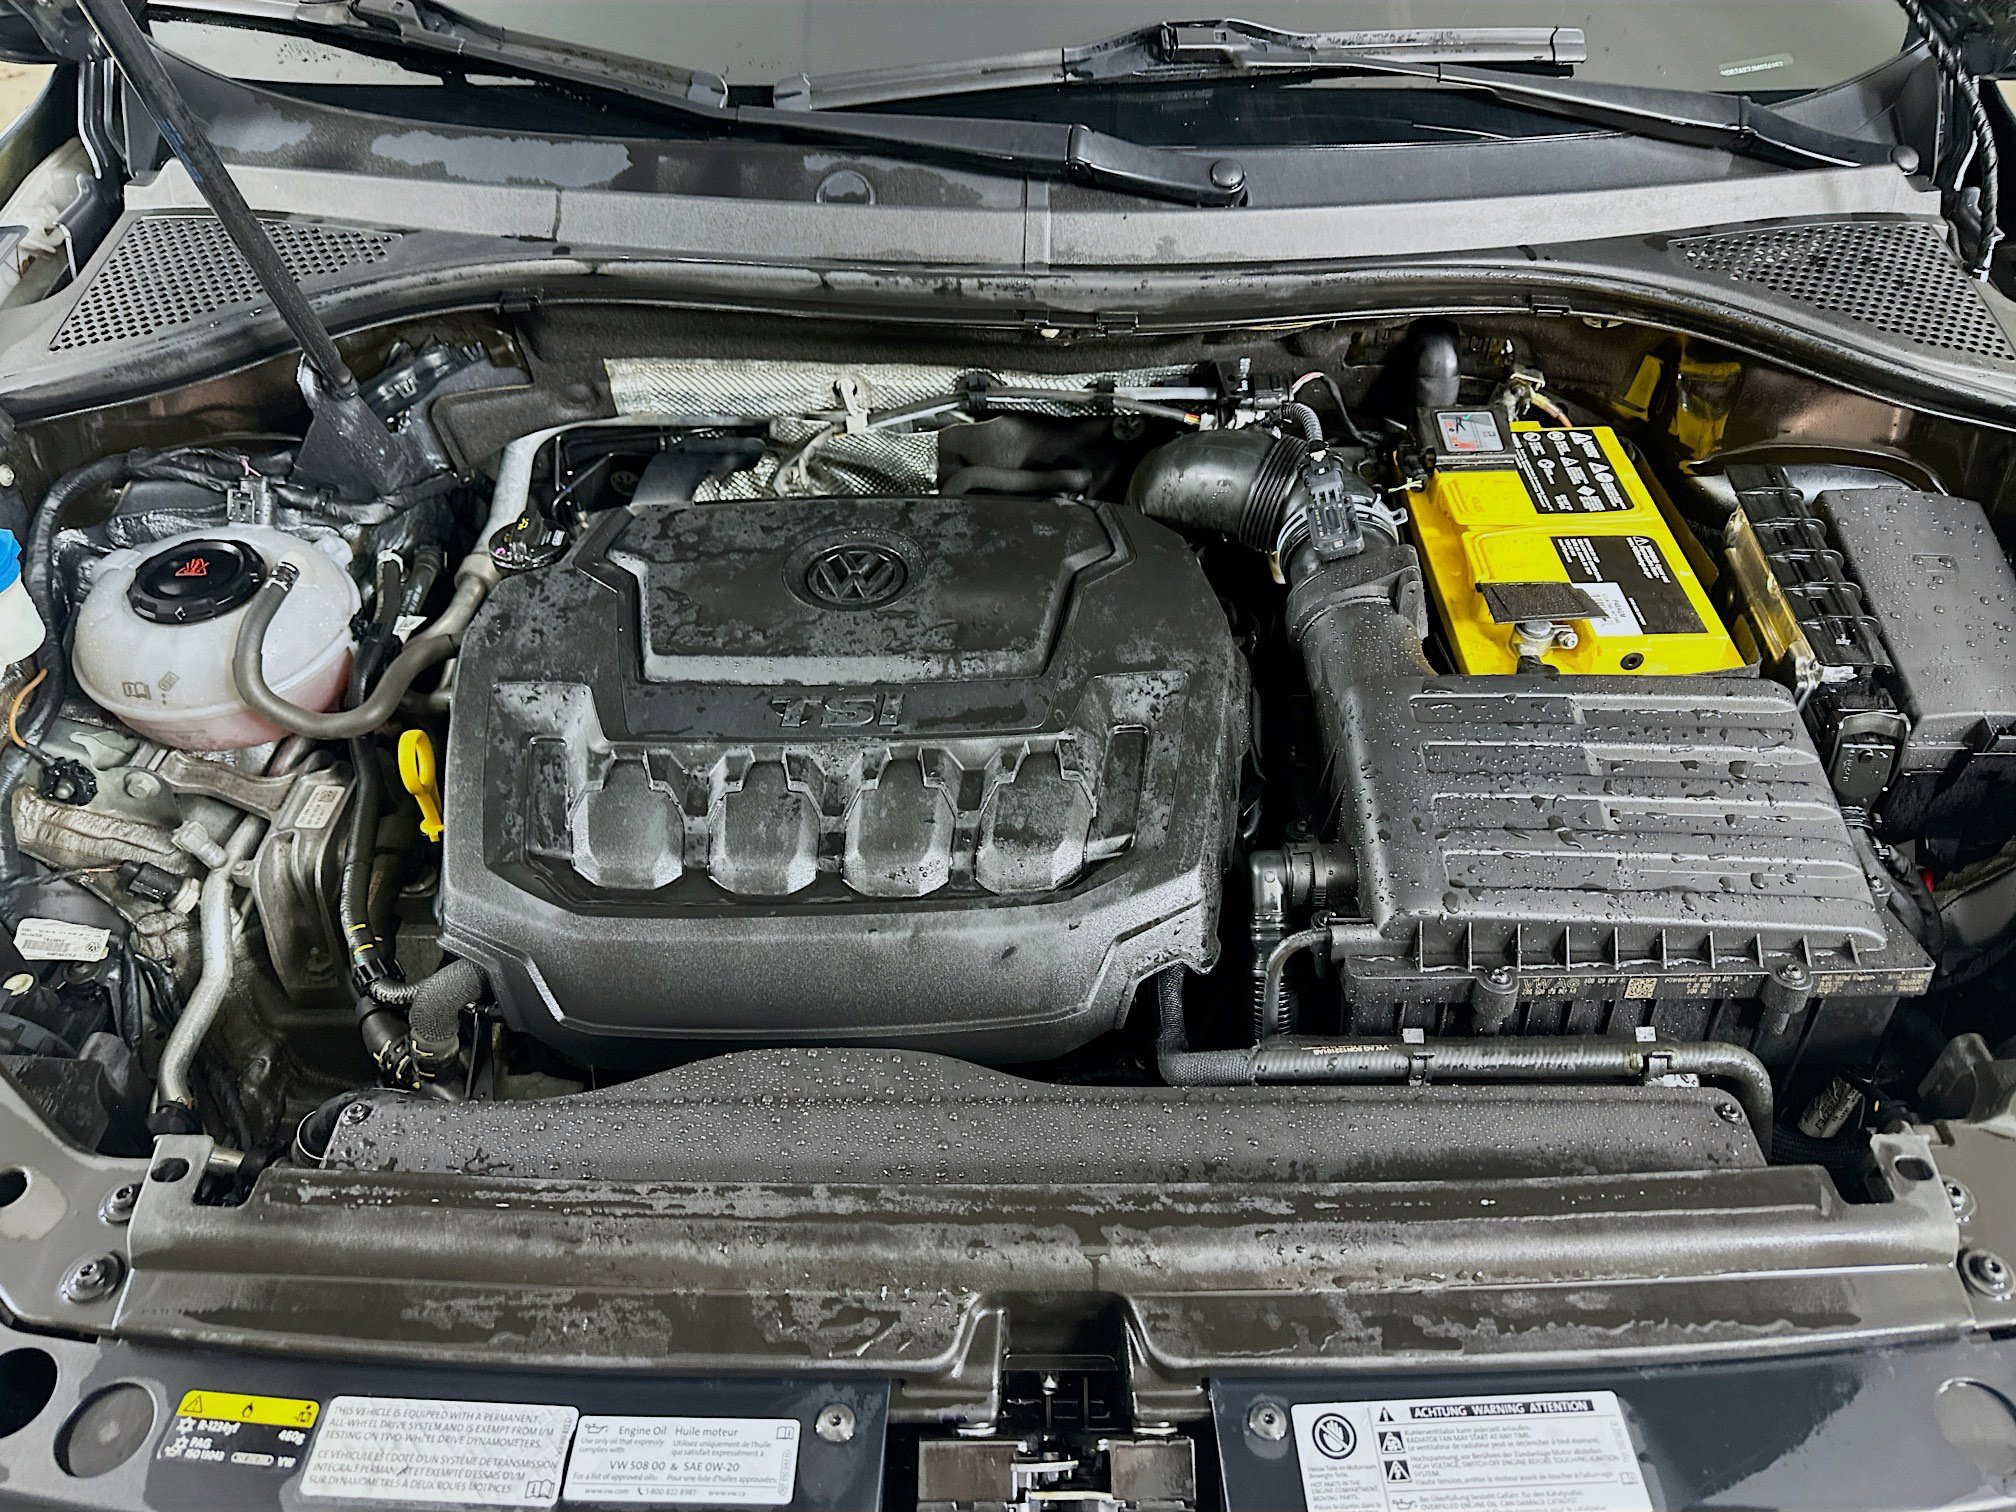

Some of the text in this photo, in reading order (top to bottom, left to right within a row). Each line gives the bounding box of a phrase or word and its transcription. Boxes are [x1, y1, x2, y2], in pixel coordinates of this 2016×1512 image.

[771, 693, 904, 728] TSI
[1523, 978, 1553, 989] VW
[335, 1406, 538, 1423] THIS VEHICLE IS EQUIPPED WITH A PERMANENT
[1414, 1400, 1589, 1418] ACHTUNG WARNING ATTENTION
[197, 1419, 241, 1436] R-1234yf
[329, 1419, 554, 1436] ALL-WHEEL DRIVE SYSTEM AND IS EXEMPT FROM I/M
[618, 1425, 667, 1437] Engine Oil
[675, 1426, 739, 1437] Huile moteur
[189, 1437, 213, 1450] PAG
[278, 1429, 306, 1447] 460g
[325, 1430, 541, 1448] TESTING ON TWO-WHEEL DRIVE DYNAMOMETERS.
[597, 1437, 608, 1446] only
[633, 1438, 665, 1447] expressly
[578, 1447, 608, 1455] complies
[699, 1441, 740, 1449] uniquement
[277, 1456, 297, 1468] VW
[416, 1454, 438, 1464] D'UN
[480, 1457, 492, 1467] DE
[493, 1458, 559, 1469] TRANSMISSION
[609, 1460, 740, 1472] VW 508 00 & SAE 0W-20
[414, 1467, 424, 1476] ET
[573, 1472, 584, 1480] For
[590, 1472, 601, 1480] list
[602, 1472, 611, 1480] of
[611, 1473, 643, 1482] approved
[309, 1475, 327, 1484] SUR
[410, 1479, 434, 1489] DEUX
[437, 1481, 466, 1491] ROUES
[666, 1474, 683, 1482] Pour
[697, 1474, 712, 1482] liste
[712, 1475, 738, 1483] d'huiles
